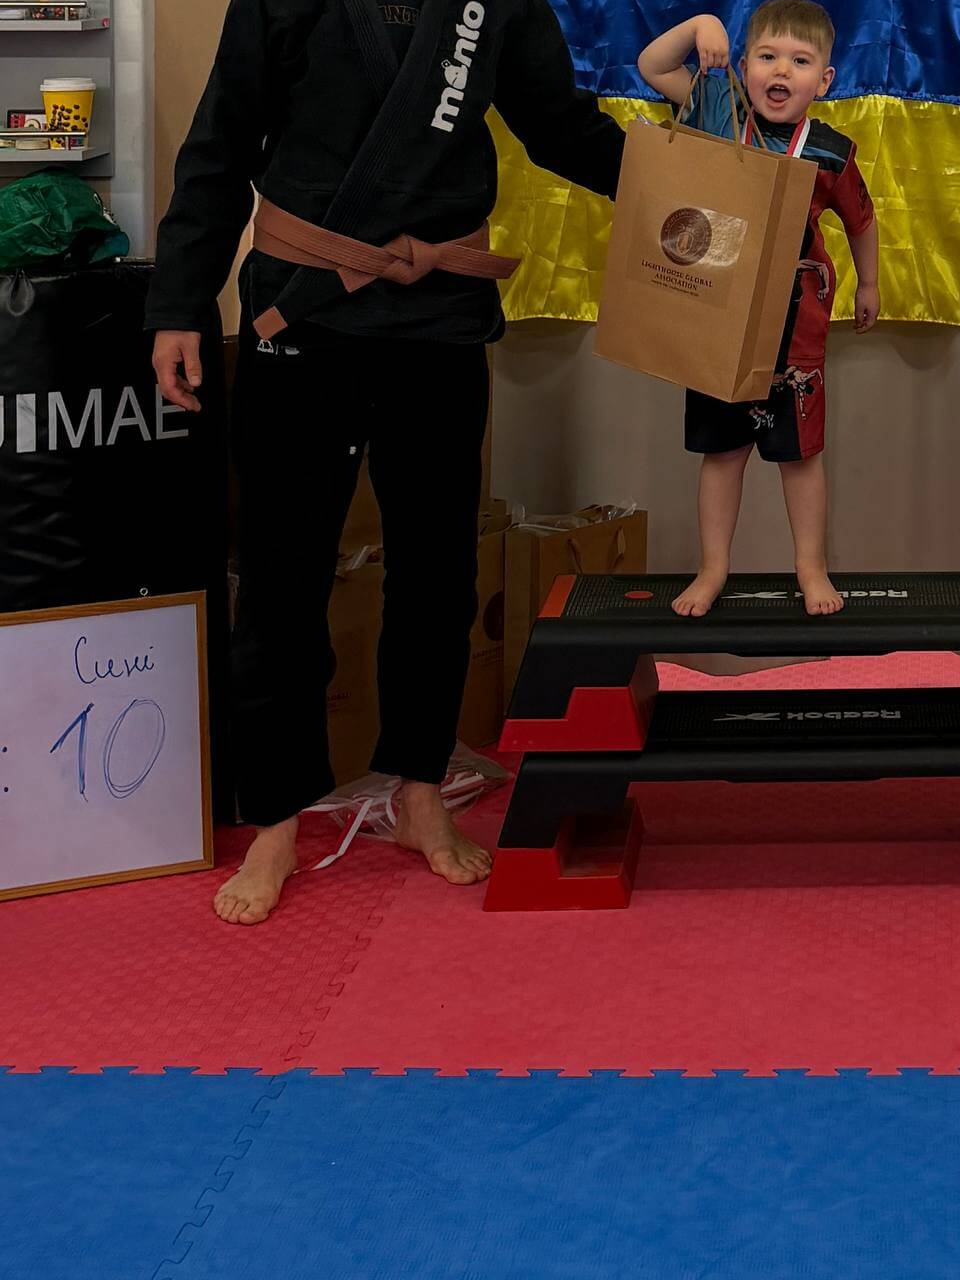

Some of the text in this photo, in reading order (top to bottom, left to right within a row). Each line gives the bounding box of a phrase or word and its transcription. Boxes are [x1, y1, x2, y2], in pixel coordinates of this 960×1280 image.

[641, 260, 684, 278] LIGHTHOUSE
[685, 274, 713, 288] GLOBAL
[654, 272, 698, 291] ASSOCIATION
[787, 709, 902, 721] Reebok
[50, 699, 166, 803] 10
